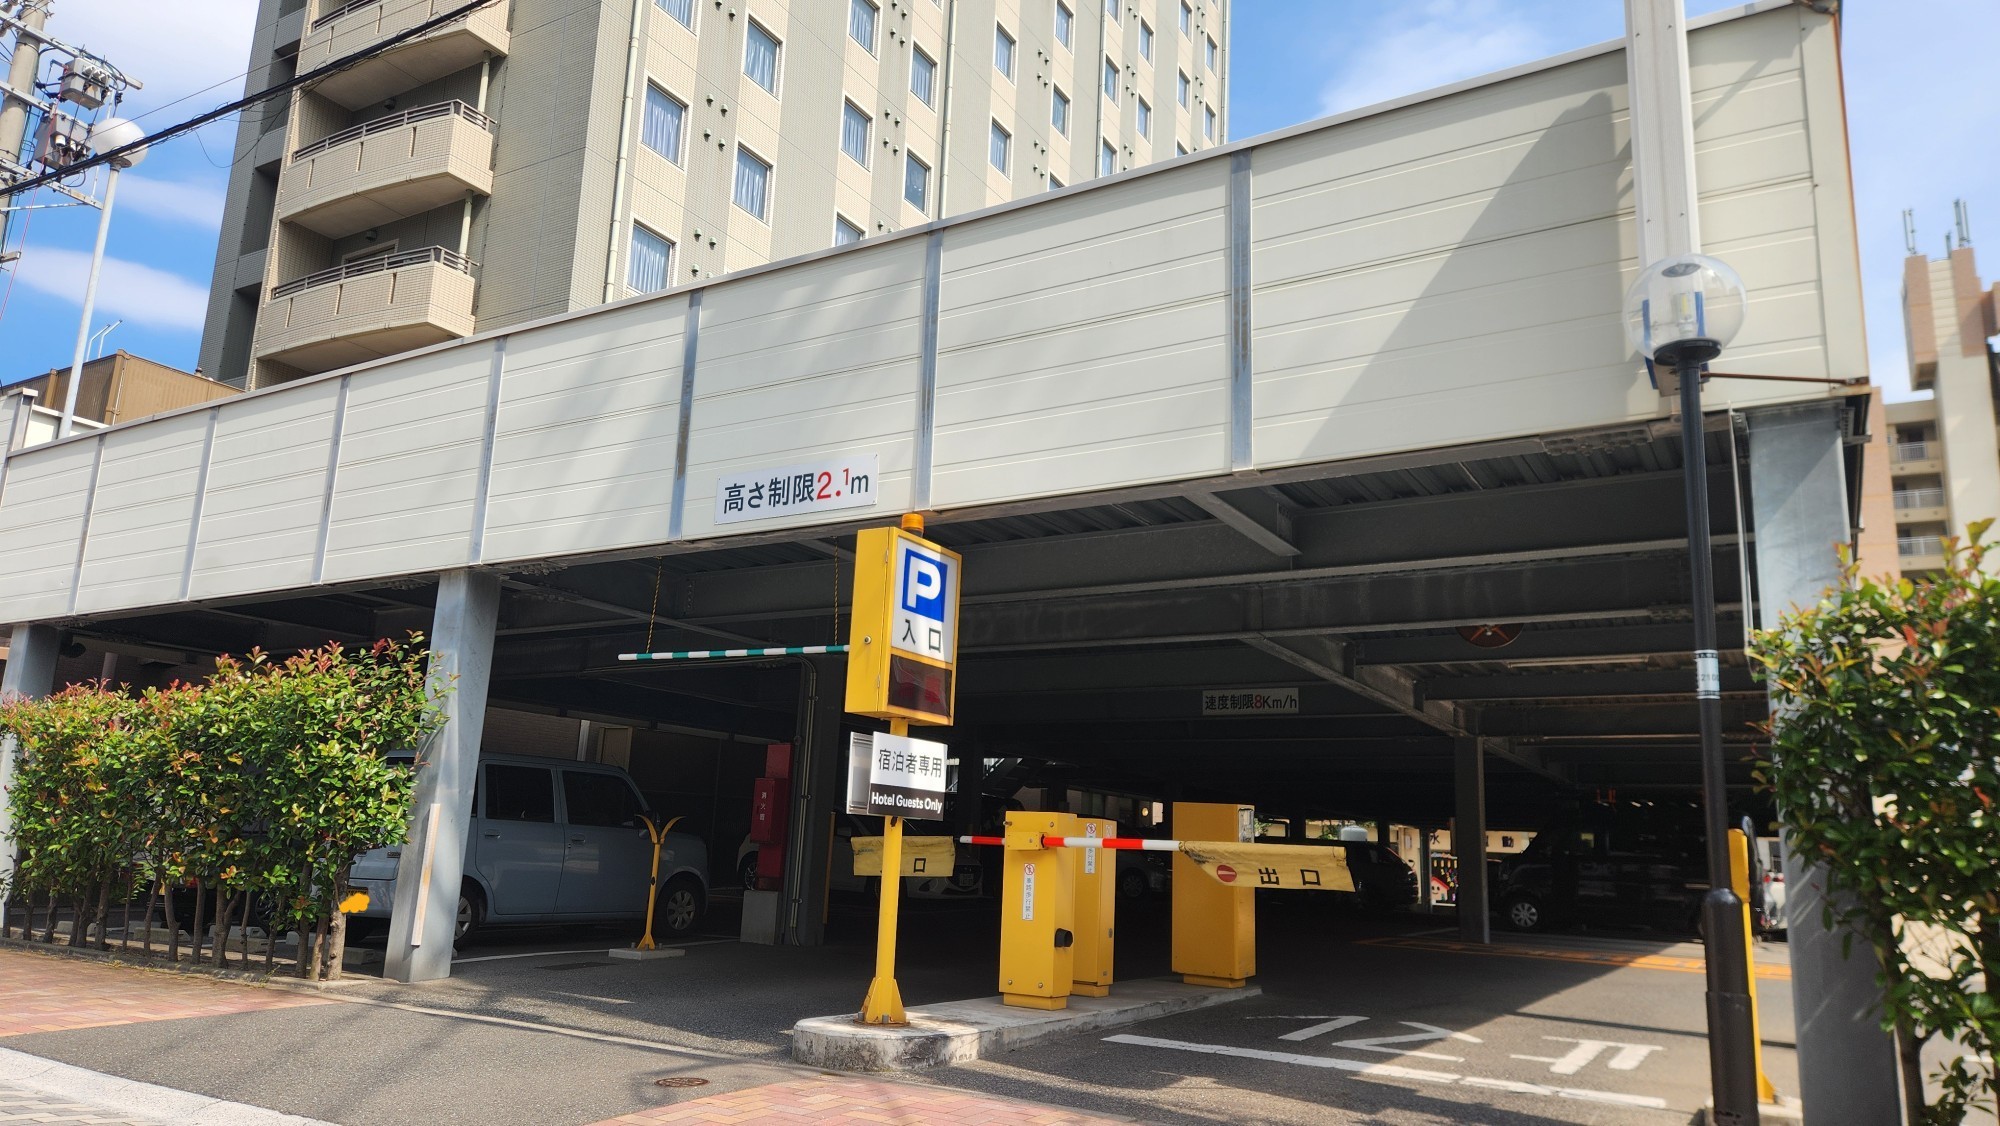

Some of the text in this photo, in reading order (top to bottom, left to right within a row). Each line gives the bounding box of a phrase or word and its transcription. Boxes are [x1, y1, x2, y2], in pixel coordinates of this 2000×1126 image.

[724, 468, 869, 514] 高さ制限2.1m
[907, 556, 941, 609] P
[902, 619, 941, 653] 入口
[1205, 694, 1297, 710] 速度制限8Km/h
[879, 748, 942, 778] 宿泊者専用
[871, 792, 942, 814] Hotel Guests Only
[1258, 867, 1322, 886] 出口
